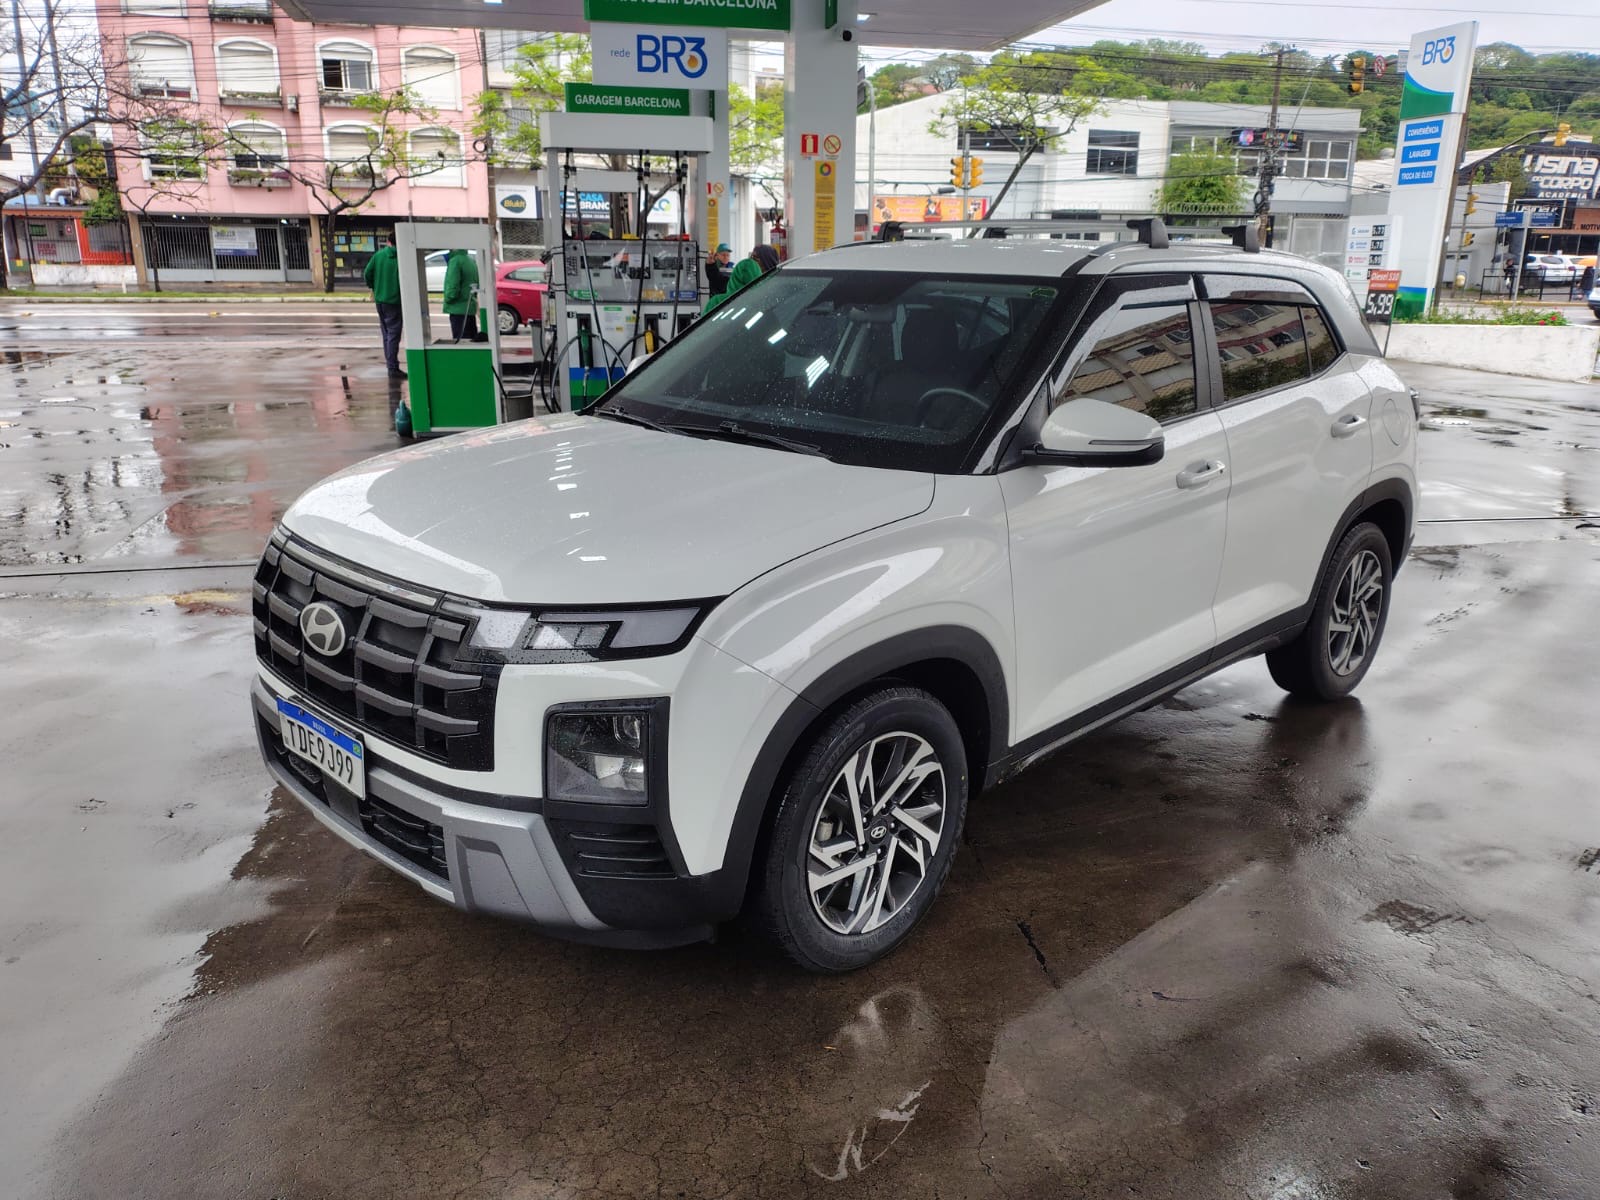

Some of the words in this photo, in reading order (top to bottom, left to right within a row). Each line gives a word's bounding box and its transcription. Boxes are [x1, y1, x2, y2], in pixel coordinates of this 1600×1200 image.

[610, 49, 631, 58] rede
[636, 34, 708, 79] BR3
[1422, 36, 1456, 65] BR3
[574, 94, 623, 106] GARAGEM
[624, 96, 682, 109] BARCELONA
[1540, 177, 1594, 190] CORPO
[580, 191, 604, 202] CASA
[1538, 191, 1588, 200] ACADEMIA
[580, 201, 610, 210] BRANC
[1366, 293, 1395, 315] 5,99
[287, 719, 354, 784] TDE9J99
